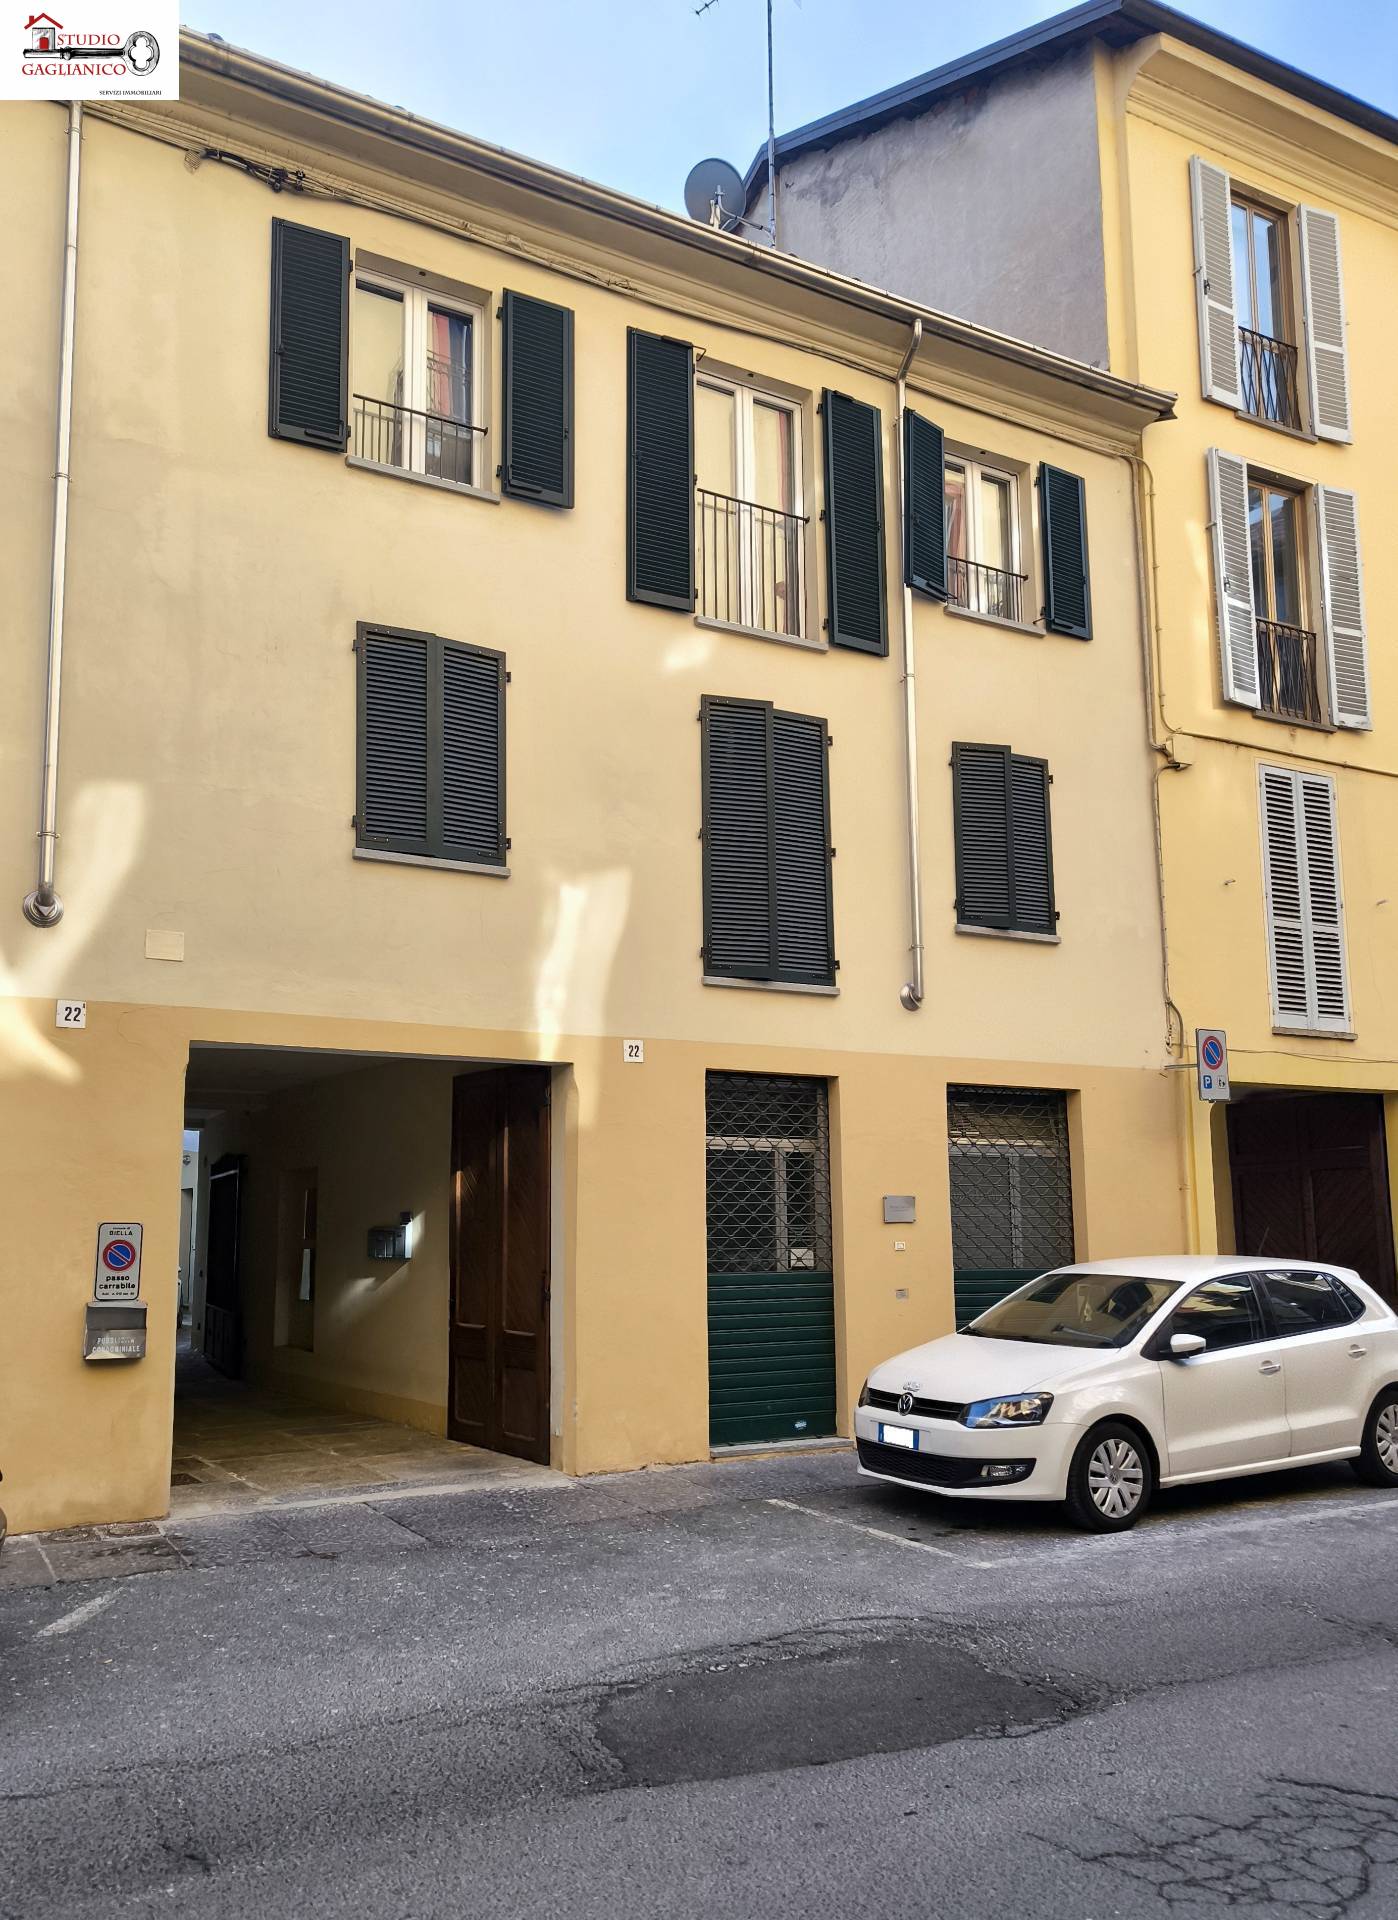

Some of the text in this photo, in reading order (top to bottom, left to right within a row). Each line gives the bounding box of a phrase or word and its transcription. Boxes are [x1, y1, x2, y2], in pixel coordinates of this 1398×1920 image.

[64, 1006, 81, 1022] 22
[628, 1044, 640, 1058] 22
[98, 1282, 136, 1290] carrabile
